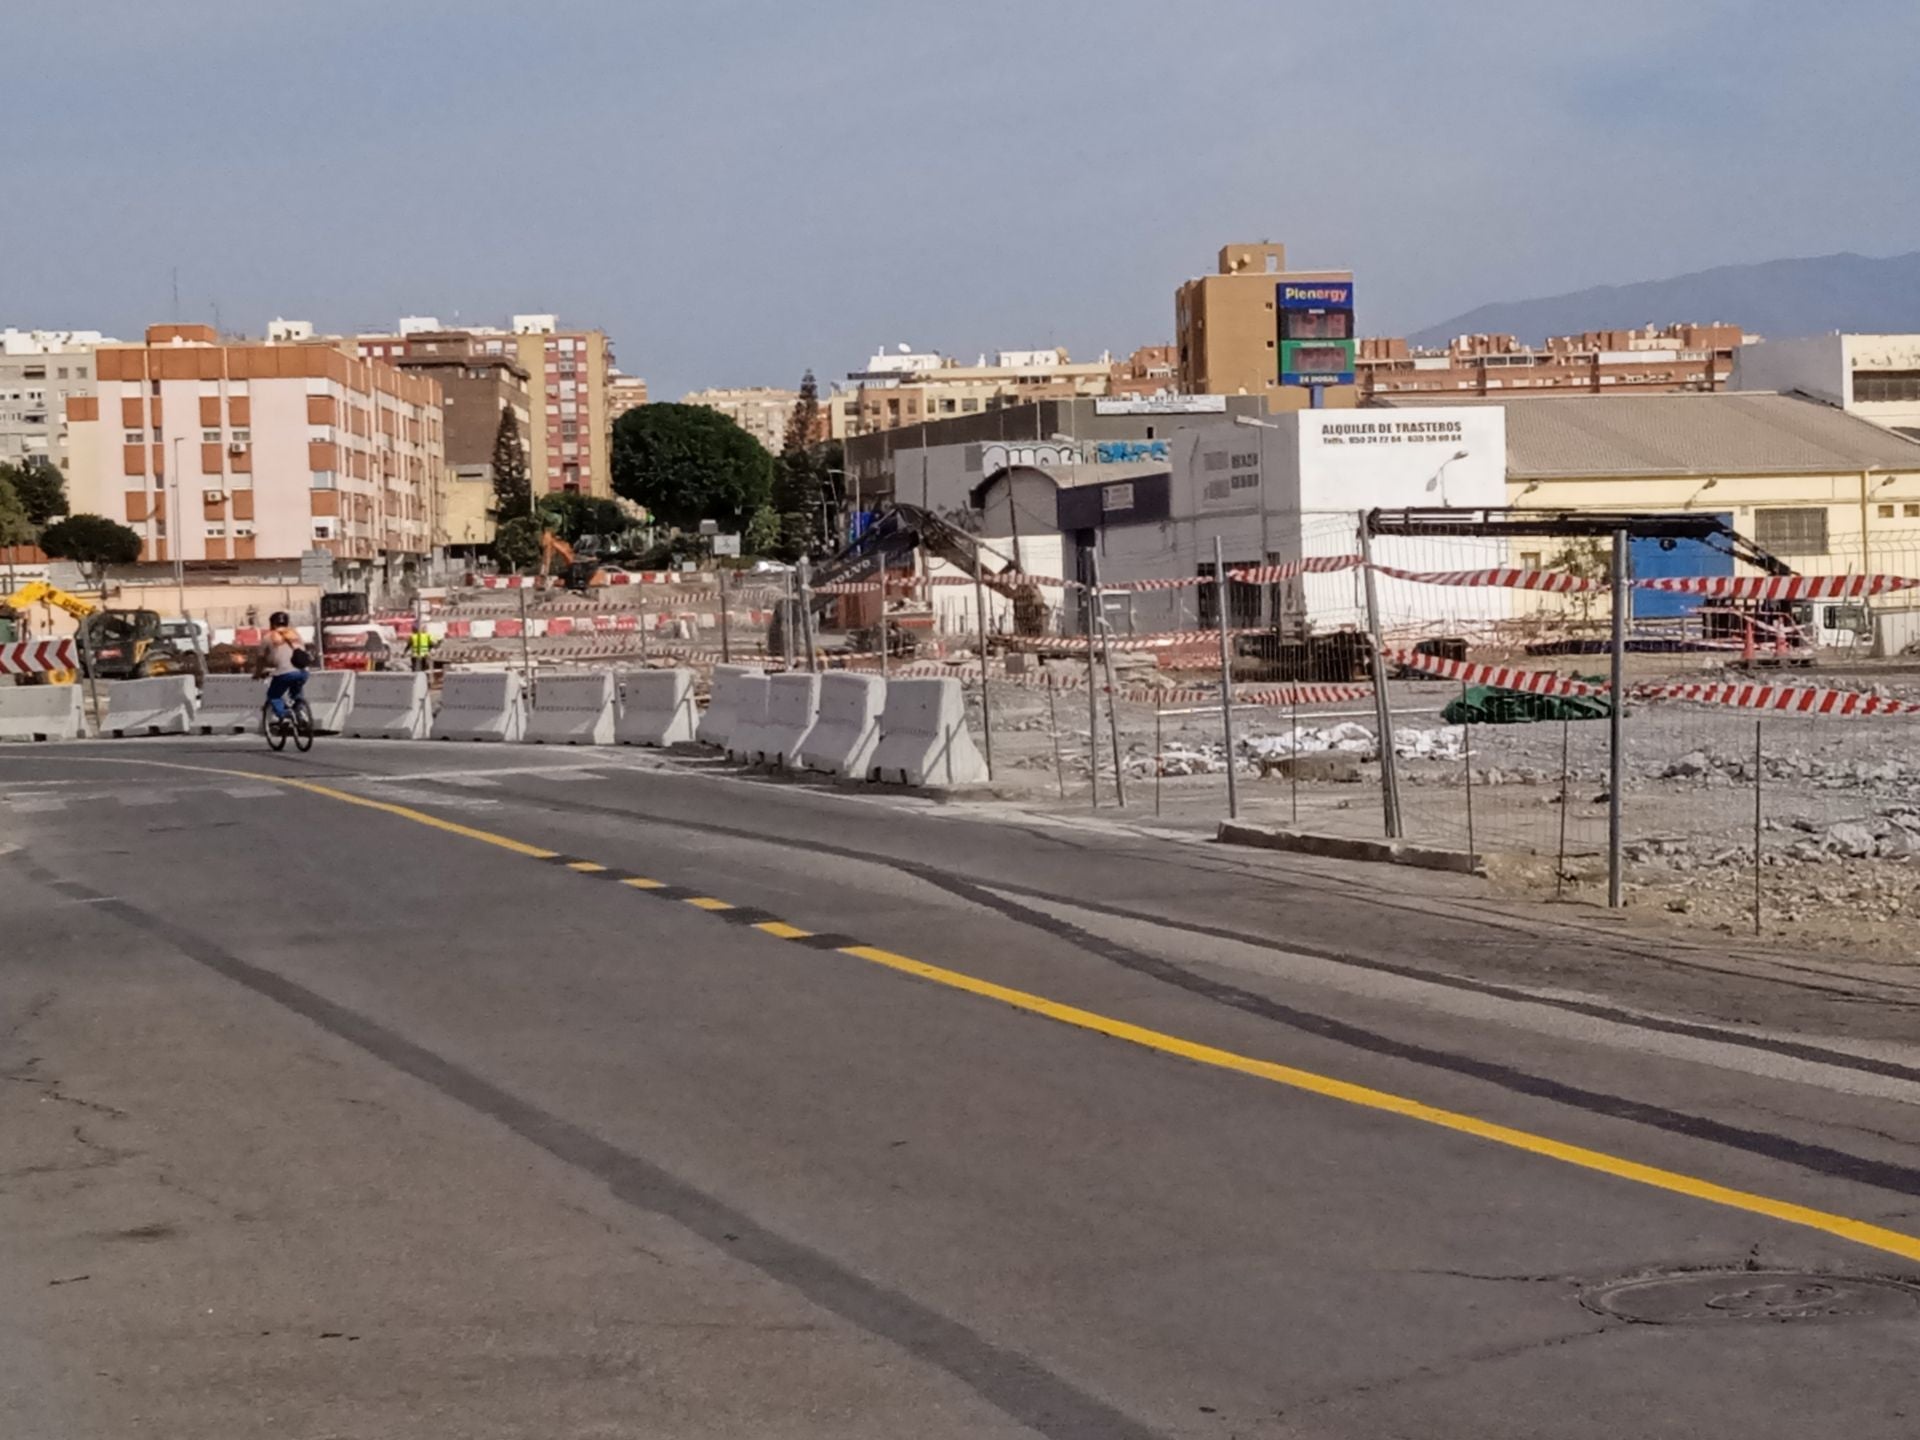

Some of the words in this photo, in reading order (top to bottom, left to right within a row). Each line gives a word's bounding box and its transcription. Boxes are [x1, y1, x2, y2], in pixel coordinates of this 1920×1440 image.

[1285, 287, 1347, 303] Plenergy
[1322, 422, 1376, 435] ALQUILER
[1378, 422, 1392, 434] DE
[1395, 421, 1462, 433] TRASTEROS
